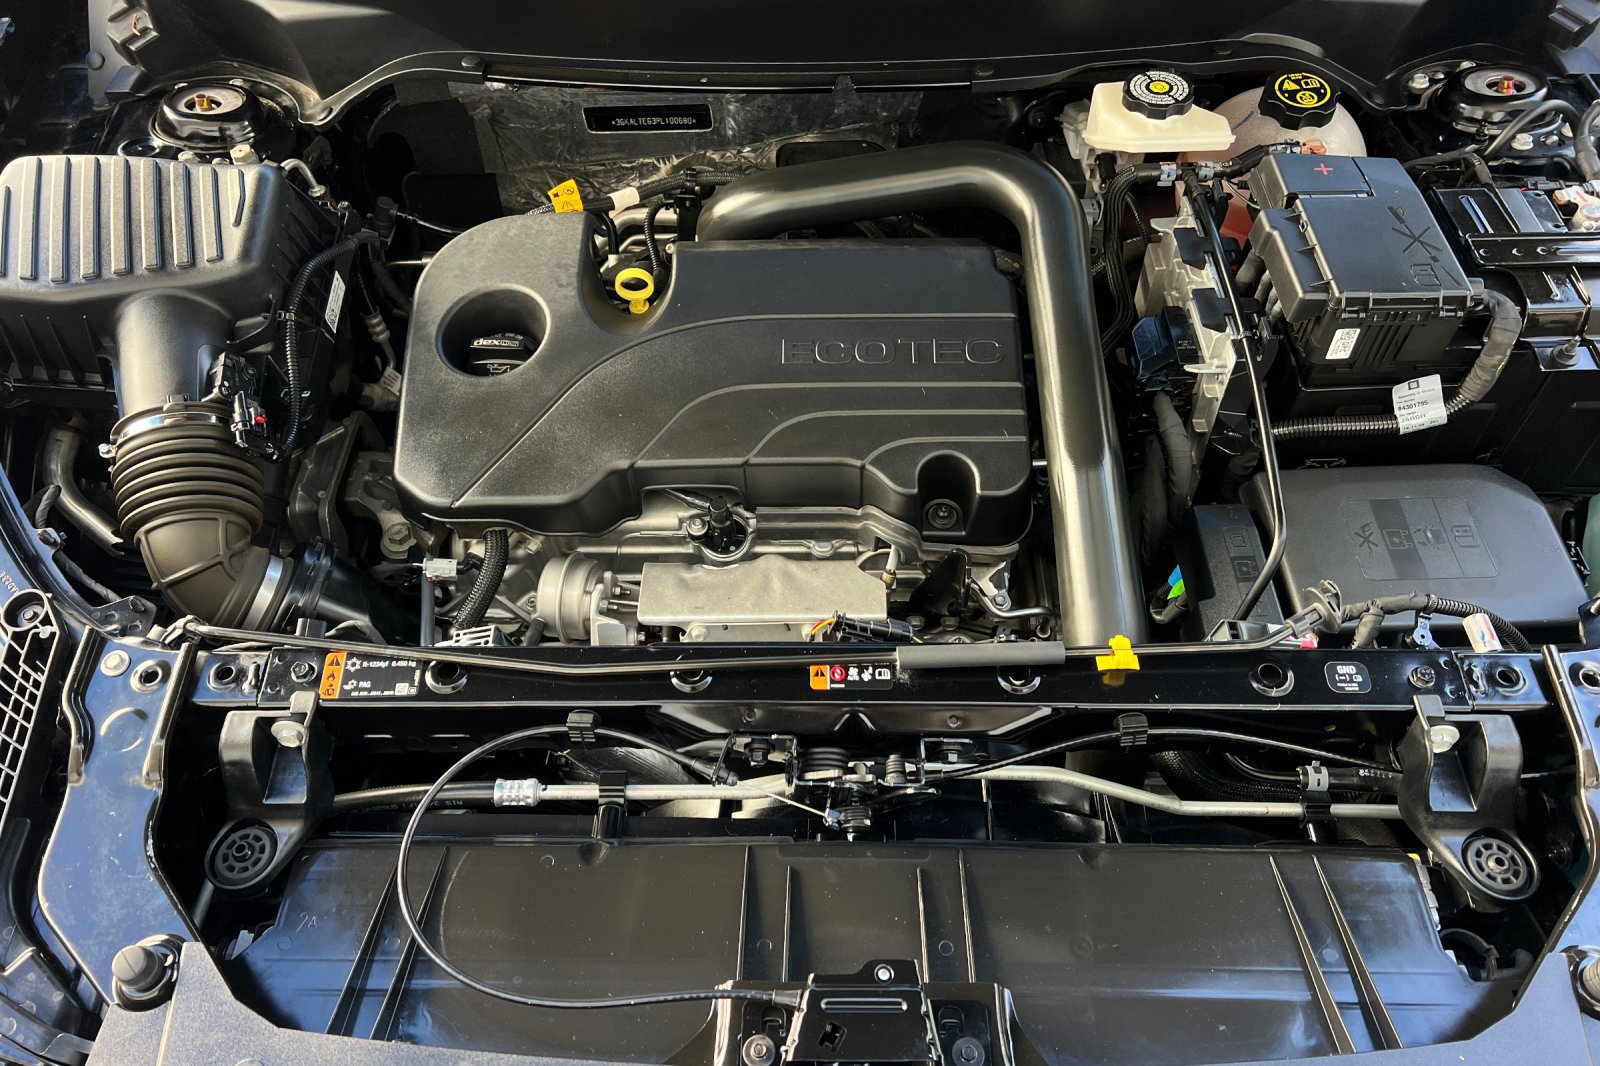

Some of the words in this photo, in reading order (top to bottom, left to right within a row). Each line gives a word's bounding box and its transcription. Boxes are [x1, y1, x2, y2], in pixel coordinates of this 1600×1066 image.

[473, 338, 519, 347] dexos
[782, 338, 1004, 364] ECOTEC
[1336, 665, 1357, 674] GND
